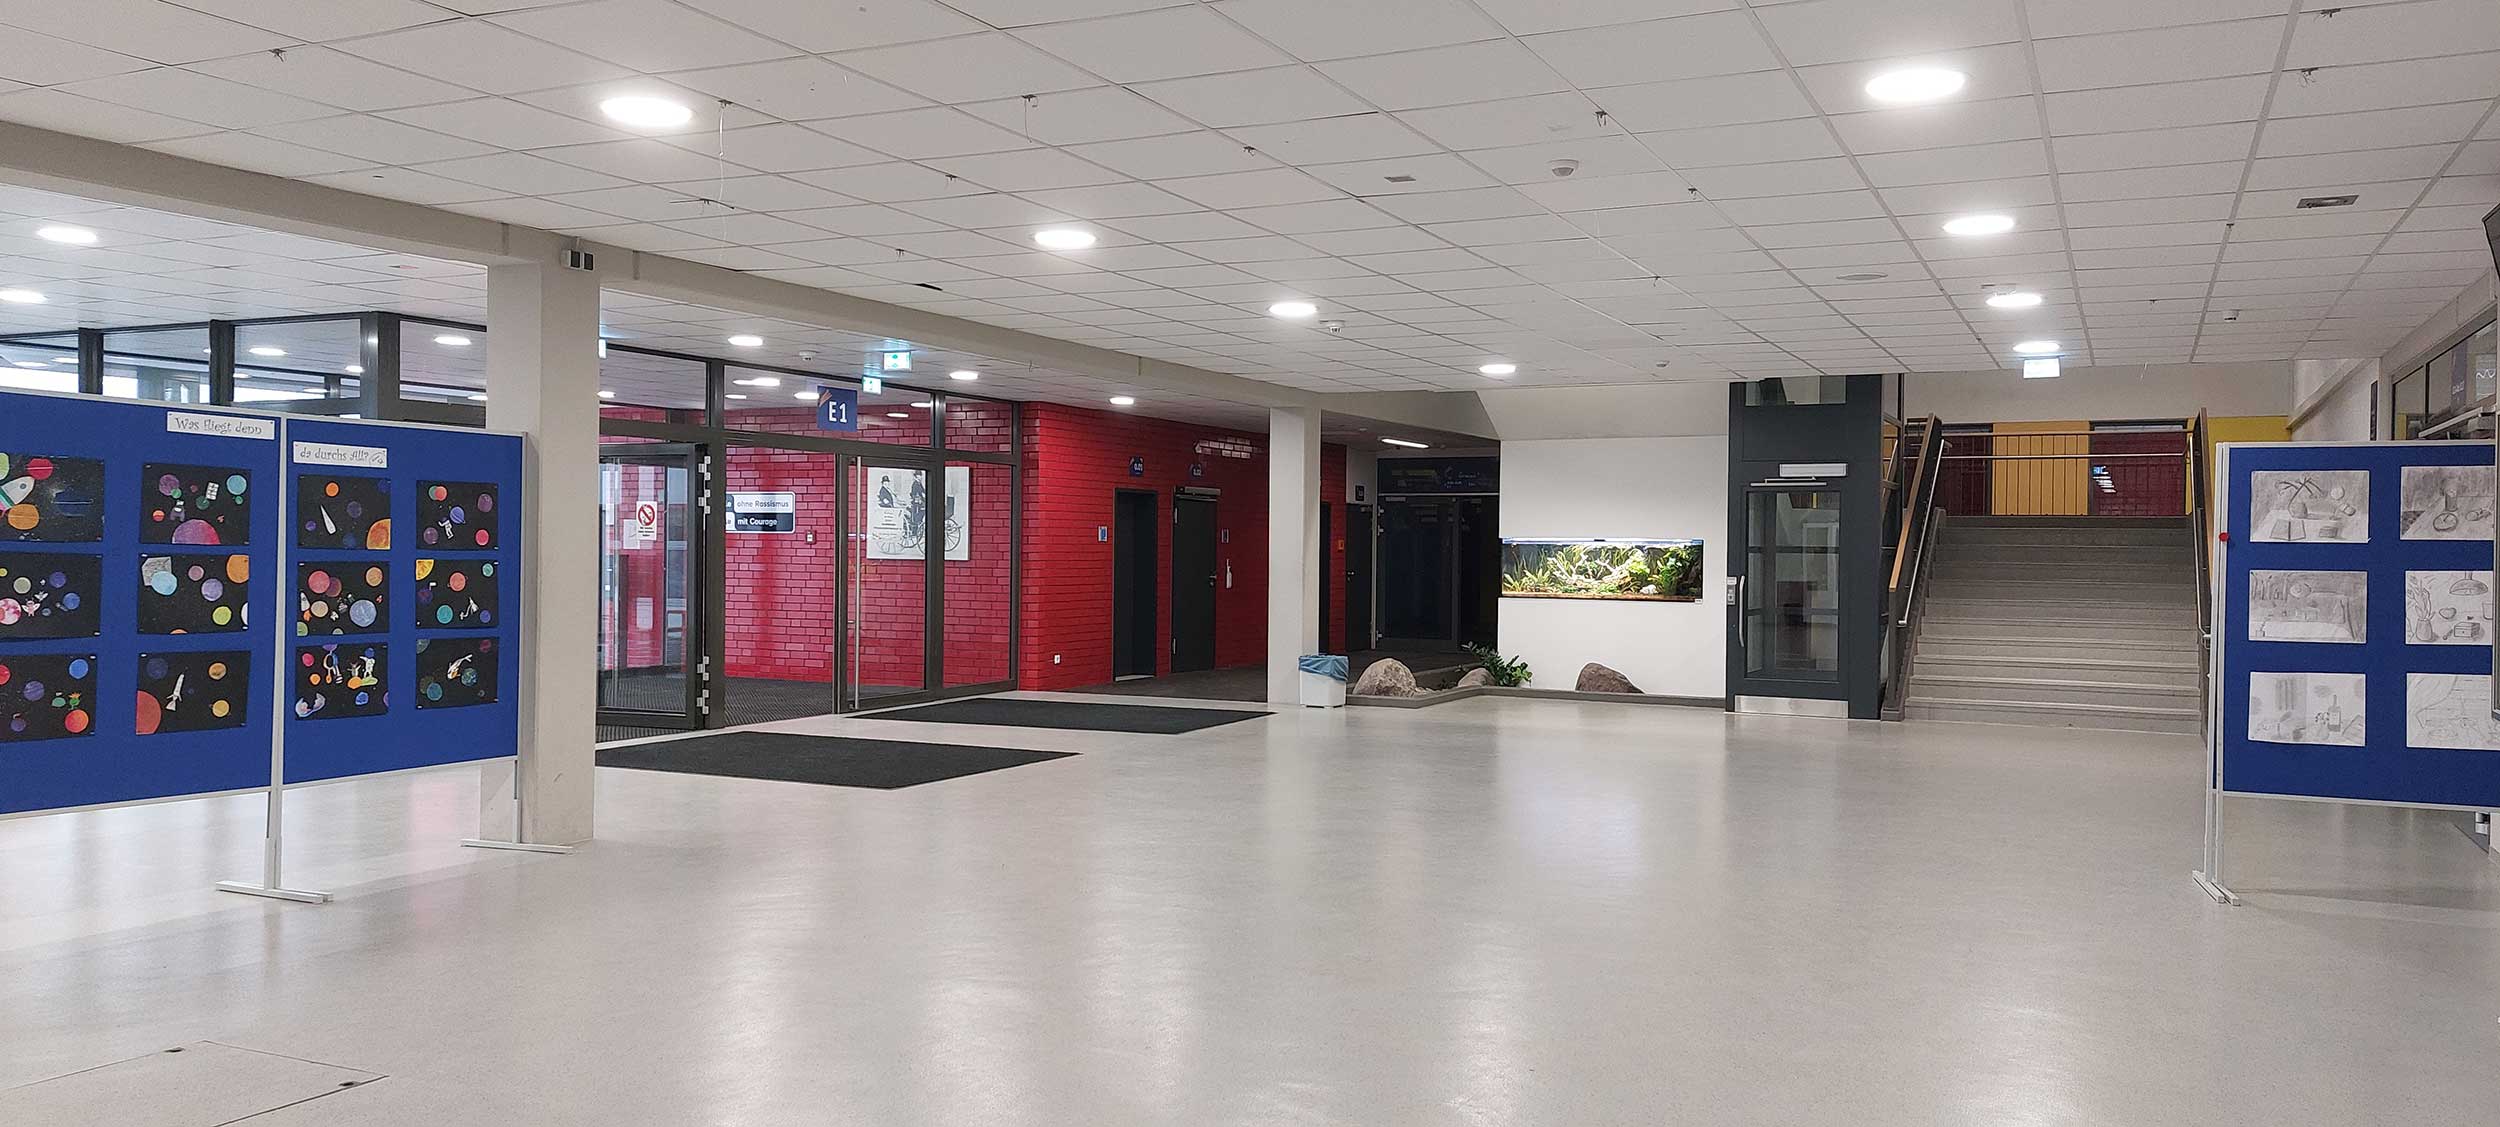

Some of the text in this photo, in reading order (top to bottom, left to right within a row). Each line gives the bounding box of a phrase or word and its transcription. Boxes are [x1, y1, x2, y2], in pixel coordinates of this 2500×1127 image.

[175, 417, 262, 434] Was fliegt denn
[300, 447, 312, 458] da
[315, 448, 347, 461] durchs
[737, 500, 753, 508] ohne
[755, 500, 789, 508] Rassismus
[737, 517, 748, 526] mit
[749, 518, 778, 527] Courage
